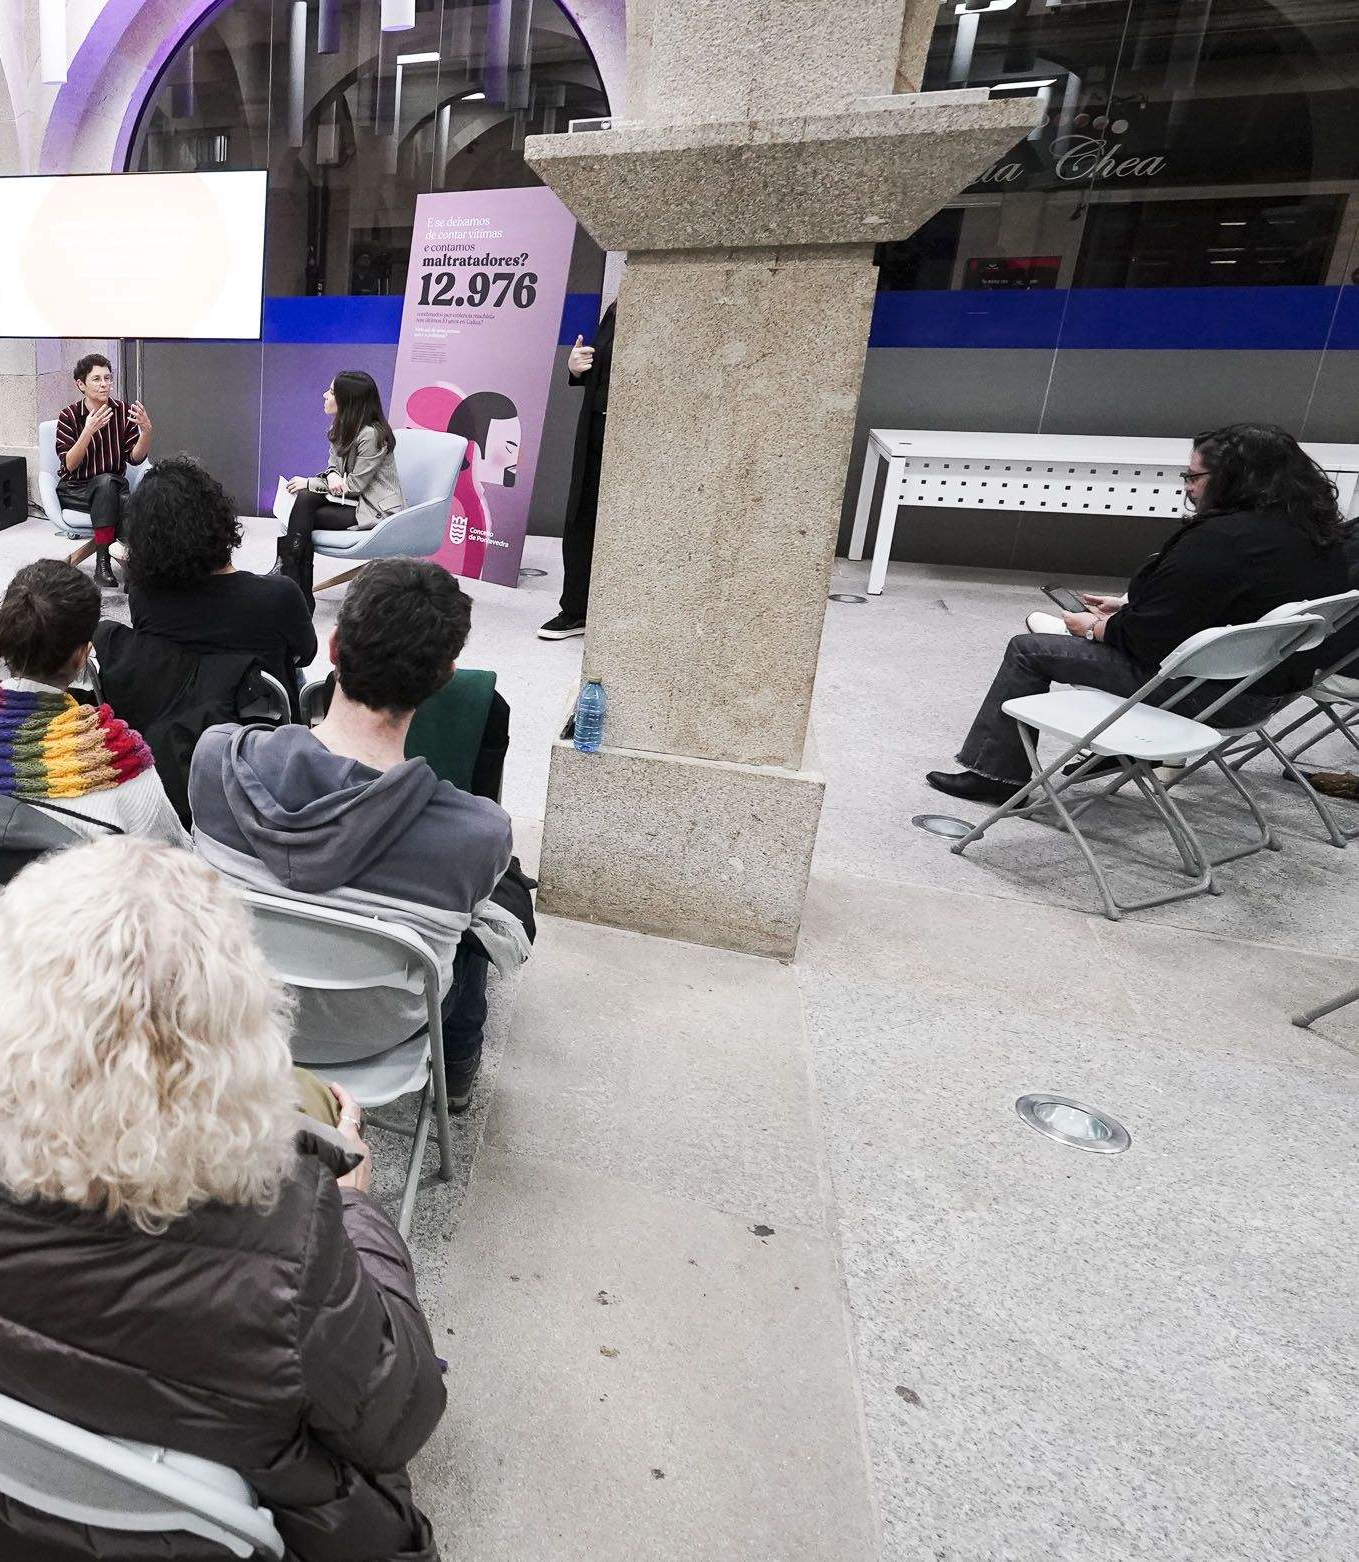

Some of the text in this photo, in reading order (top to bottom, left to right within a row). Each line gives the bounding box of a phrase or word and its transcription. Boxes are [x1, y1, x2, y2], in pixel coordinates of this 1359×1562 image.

[1048, 134, 1166, 181] Chea
[427, 216, 491, 228] E se deixamos
[425, 228, 503, 240] de contar vítimas
[430, 243, 476, 252] contamos
[422, 252, 529, 268] maltratadores?
[417, 271, 539, 309] 12.976
[476, 535, 509, 548] Pontevedra
